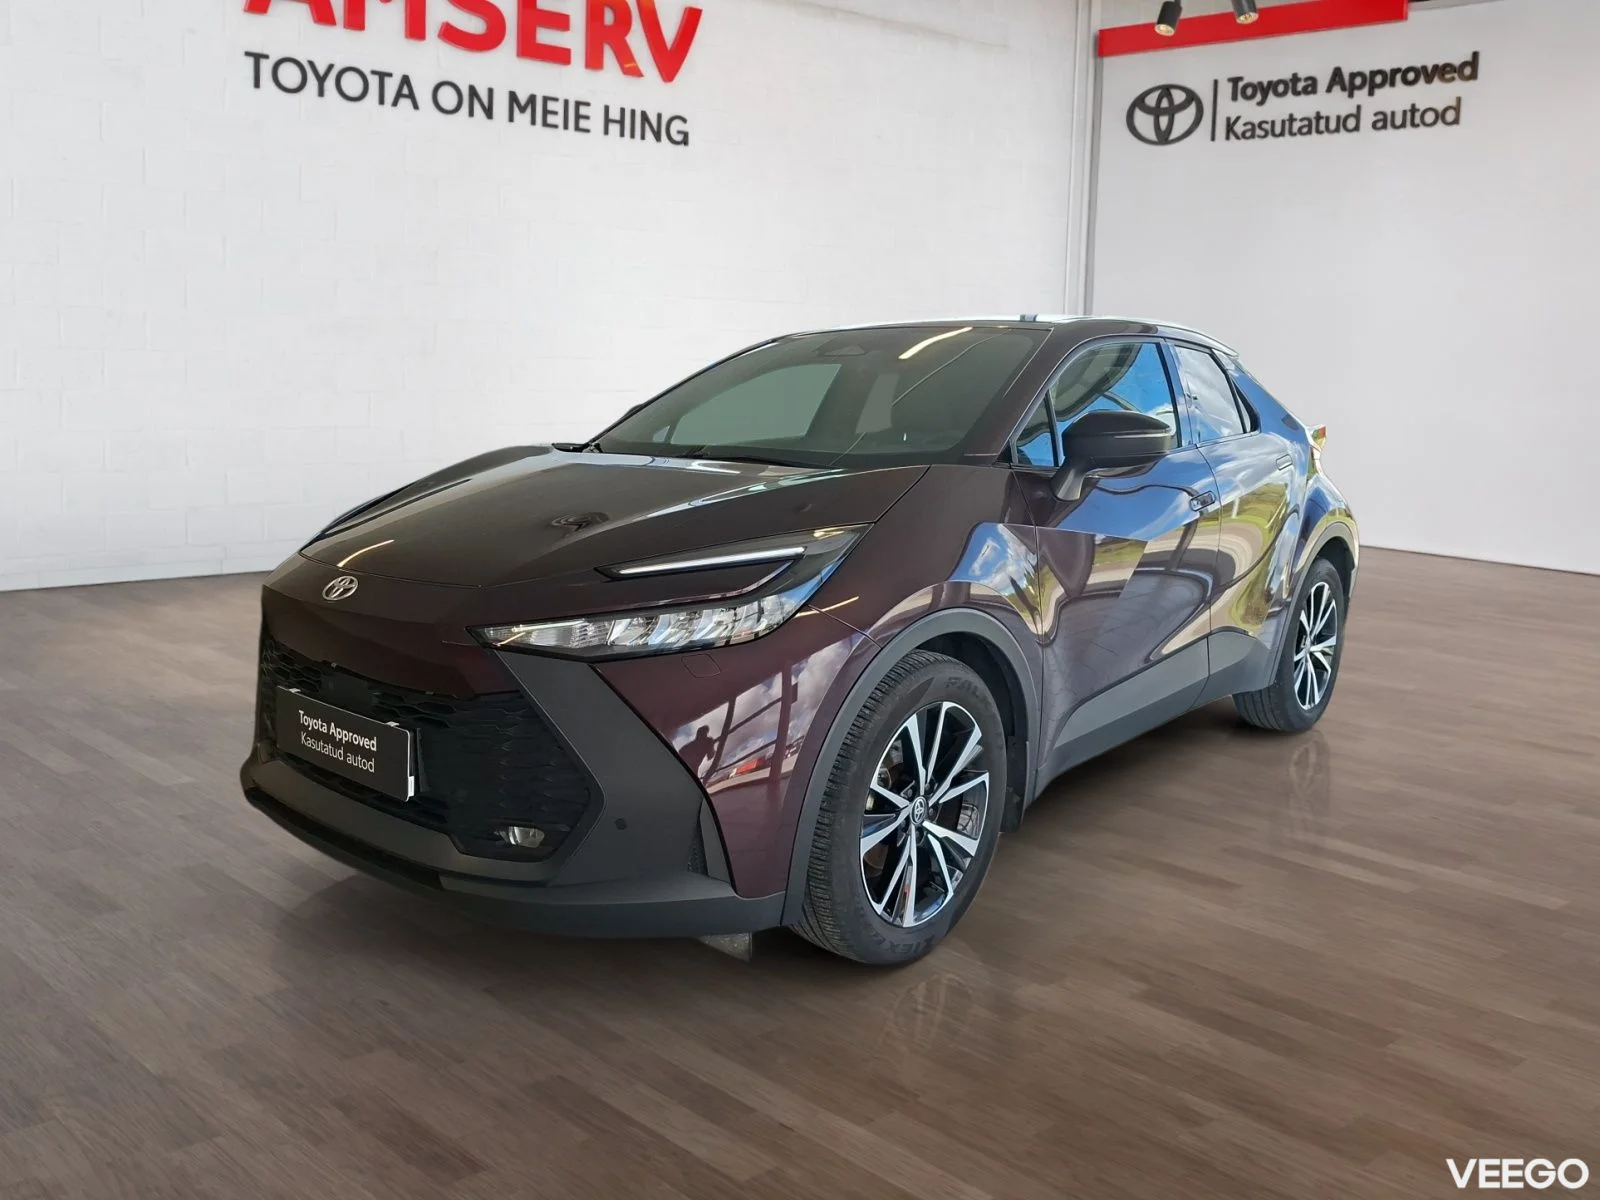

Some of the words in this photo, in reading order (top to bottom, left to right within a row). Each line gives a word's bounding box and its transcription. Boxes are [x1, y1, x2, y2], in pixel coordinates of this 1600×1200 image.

[244, 0, 702, 83] SERV
[244, 51, 419, 110] TOYOTA
[431, 80, 494, 120] ON
[507, 90, 591, 133] MEIE
[603, 104, 689, 146] HING
[1227, 72, 1318, 106] Toyota
[1325, 51, 1480, 98] Approved
[1224, 105, 1361, 141] Kasutatud
[1371, 96, 1462, 130] autod
[298, 710, 327, 733] Toyota
[329, 722, 377, 752] Approved
[301, 731, 344, 761] Kasutatud
[346, 752, 375, 773] autod
